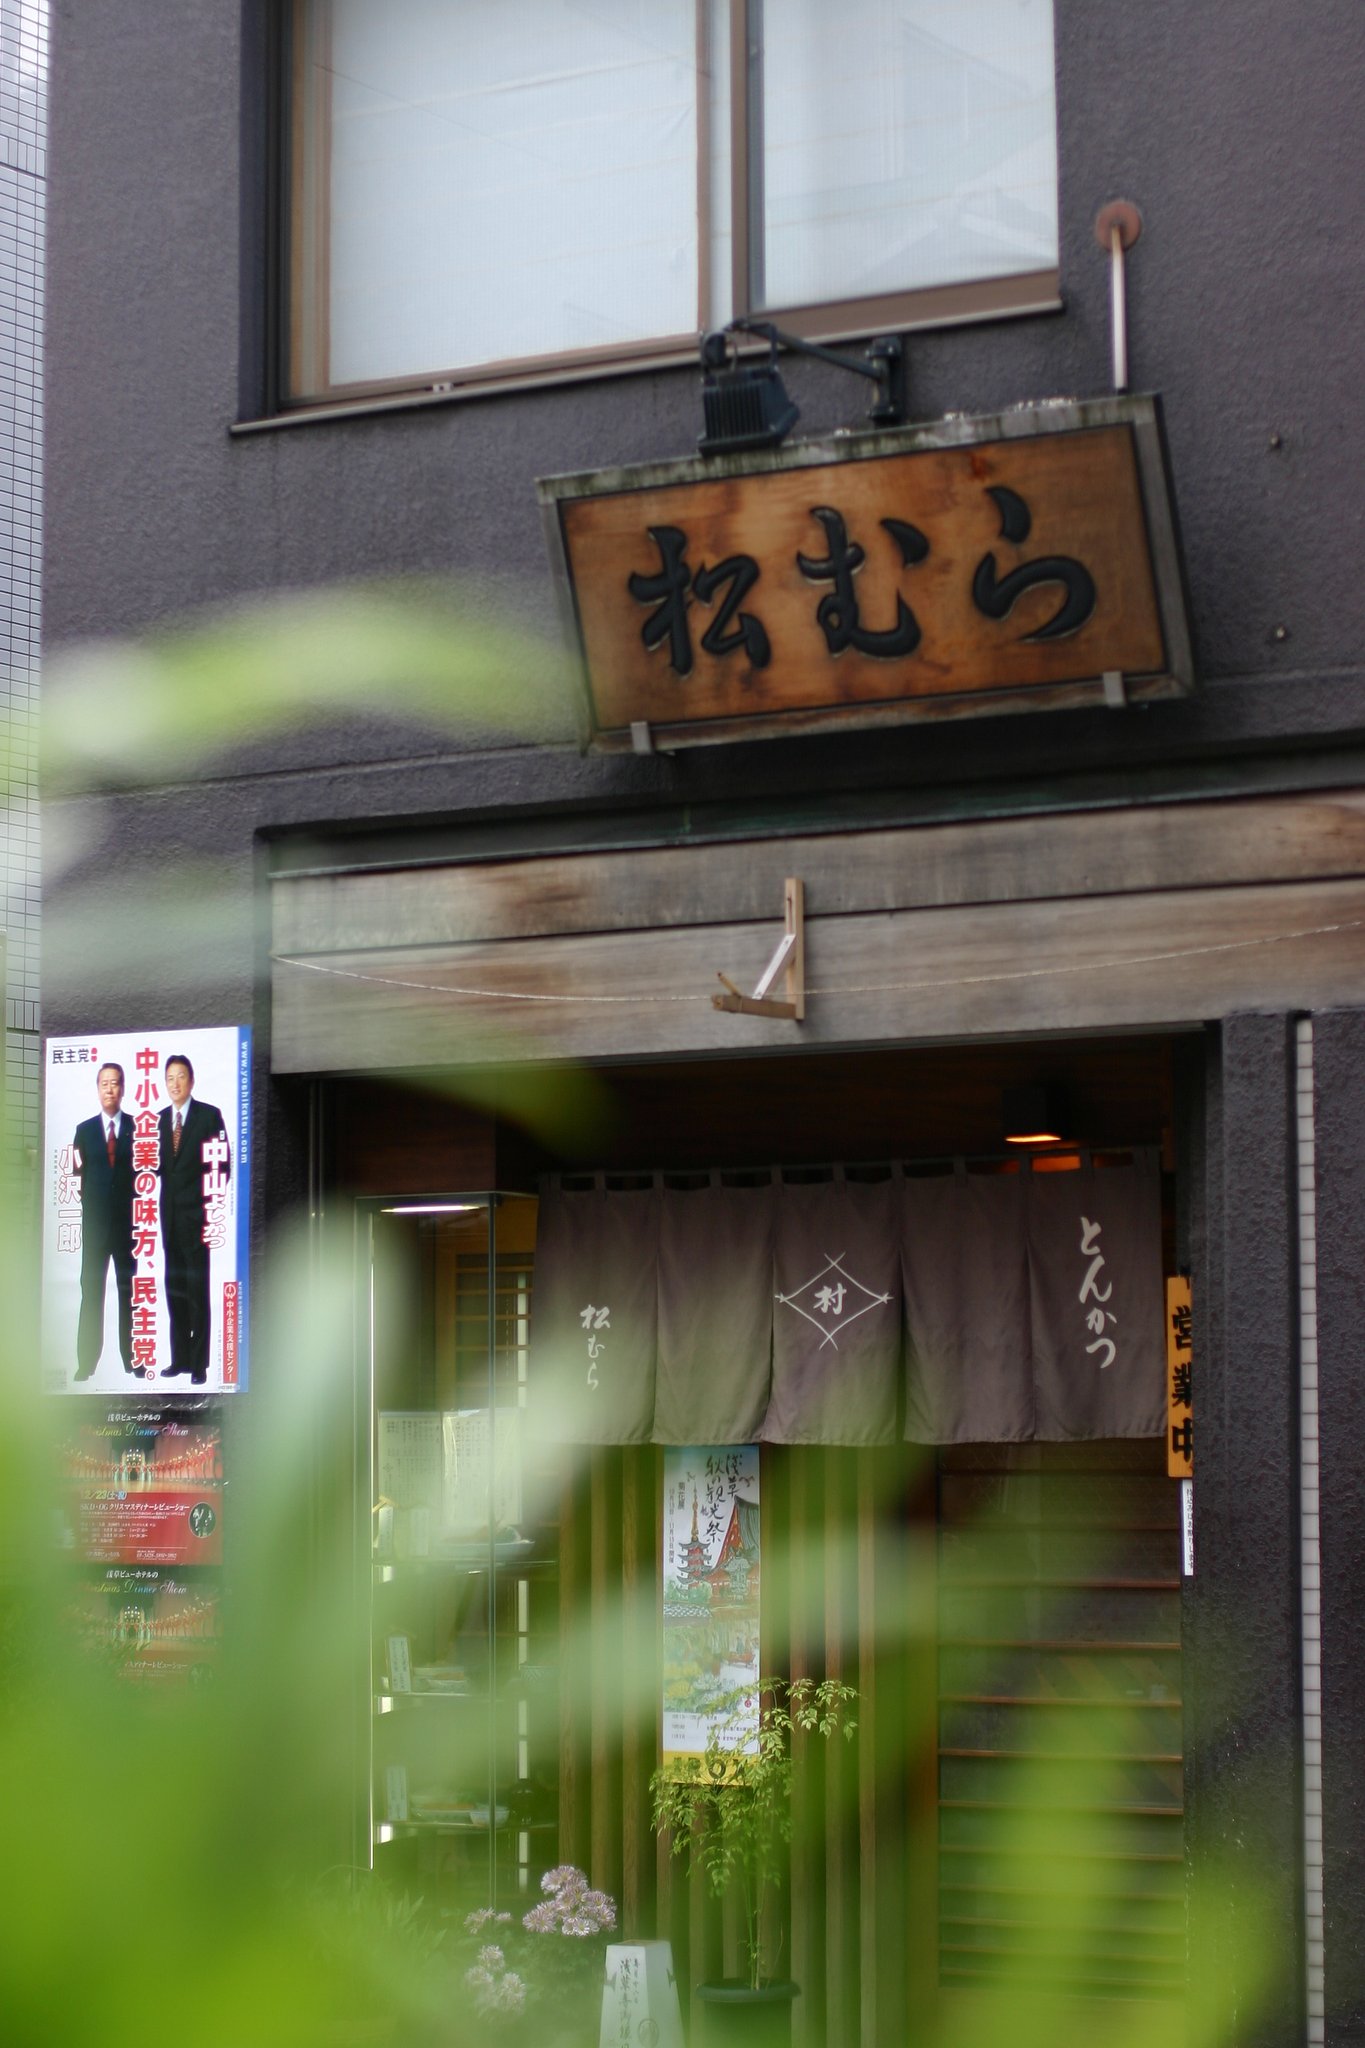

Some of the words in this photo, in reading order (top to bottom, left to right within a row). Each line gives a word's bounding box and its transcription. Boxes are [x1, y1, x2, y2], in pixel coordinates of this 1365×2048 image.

[628, 485, 1097, 676] 松むら
[52, 1048, 89, 1064] 民主党
[58, 1144, 82, 1253] 小沢一郎
[131, 1047, 159, 1381] 中小企業の味方、民主党。
[203, 1138, 228, 1249] 中山よしかつ
[813, 1283, 847, 1315] 村
[1079, 1216, 1117, 1369] とんかつ
[580, 1304, 611, 1391] 松むら
[125, 1422, 160, 1437] Dinner
